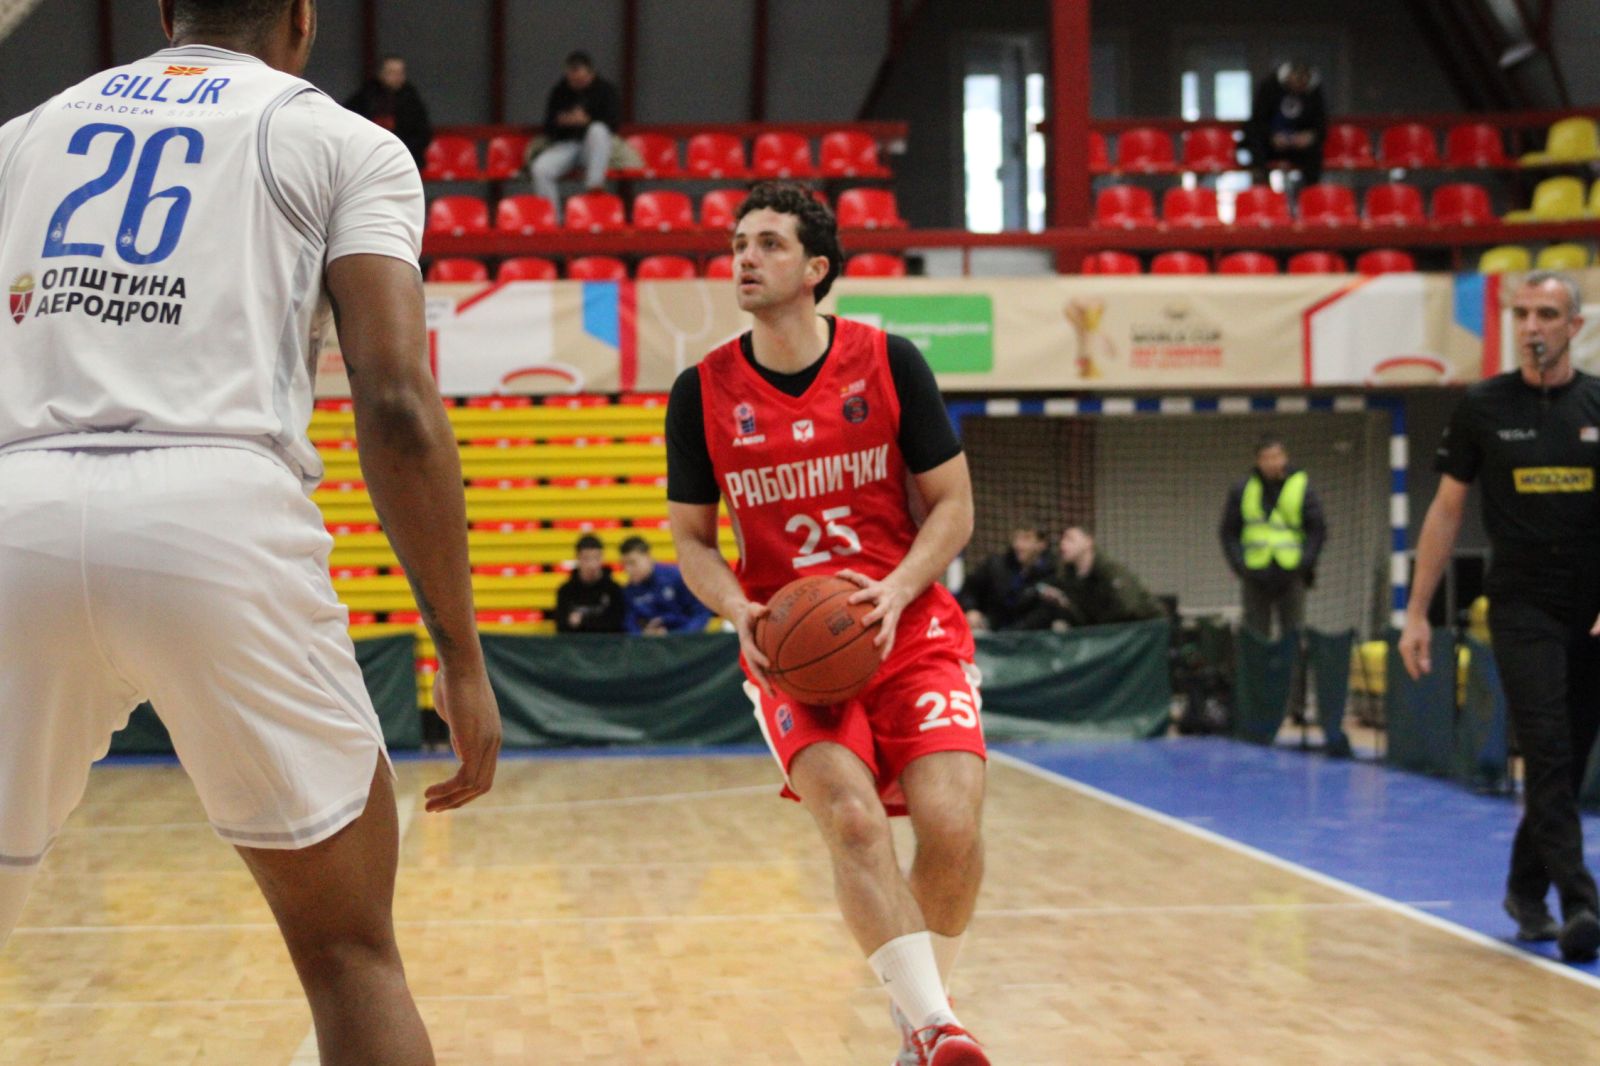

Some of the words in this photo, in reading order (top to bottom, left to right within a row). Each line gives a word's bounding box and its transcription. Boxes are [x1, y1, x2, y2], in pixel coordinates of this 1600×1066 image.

[62, 100, 155, 116] ACIBADEM
[101, 73, 172, 103] GILL
[176, 78, 231, 105] JR
[41, 122, 205, 265] 26
[41, 266, 187, 299] ОПШТИНА
[35, 291, 183, 326] АЕРОДРОМ
[724, 443, 890, 509] РАБОТНИЧКИ
[784, 505, 862, 569] 25
[915, 690, 977, 732] 25
